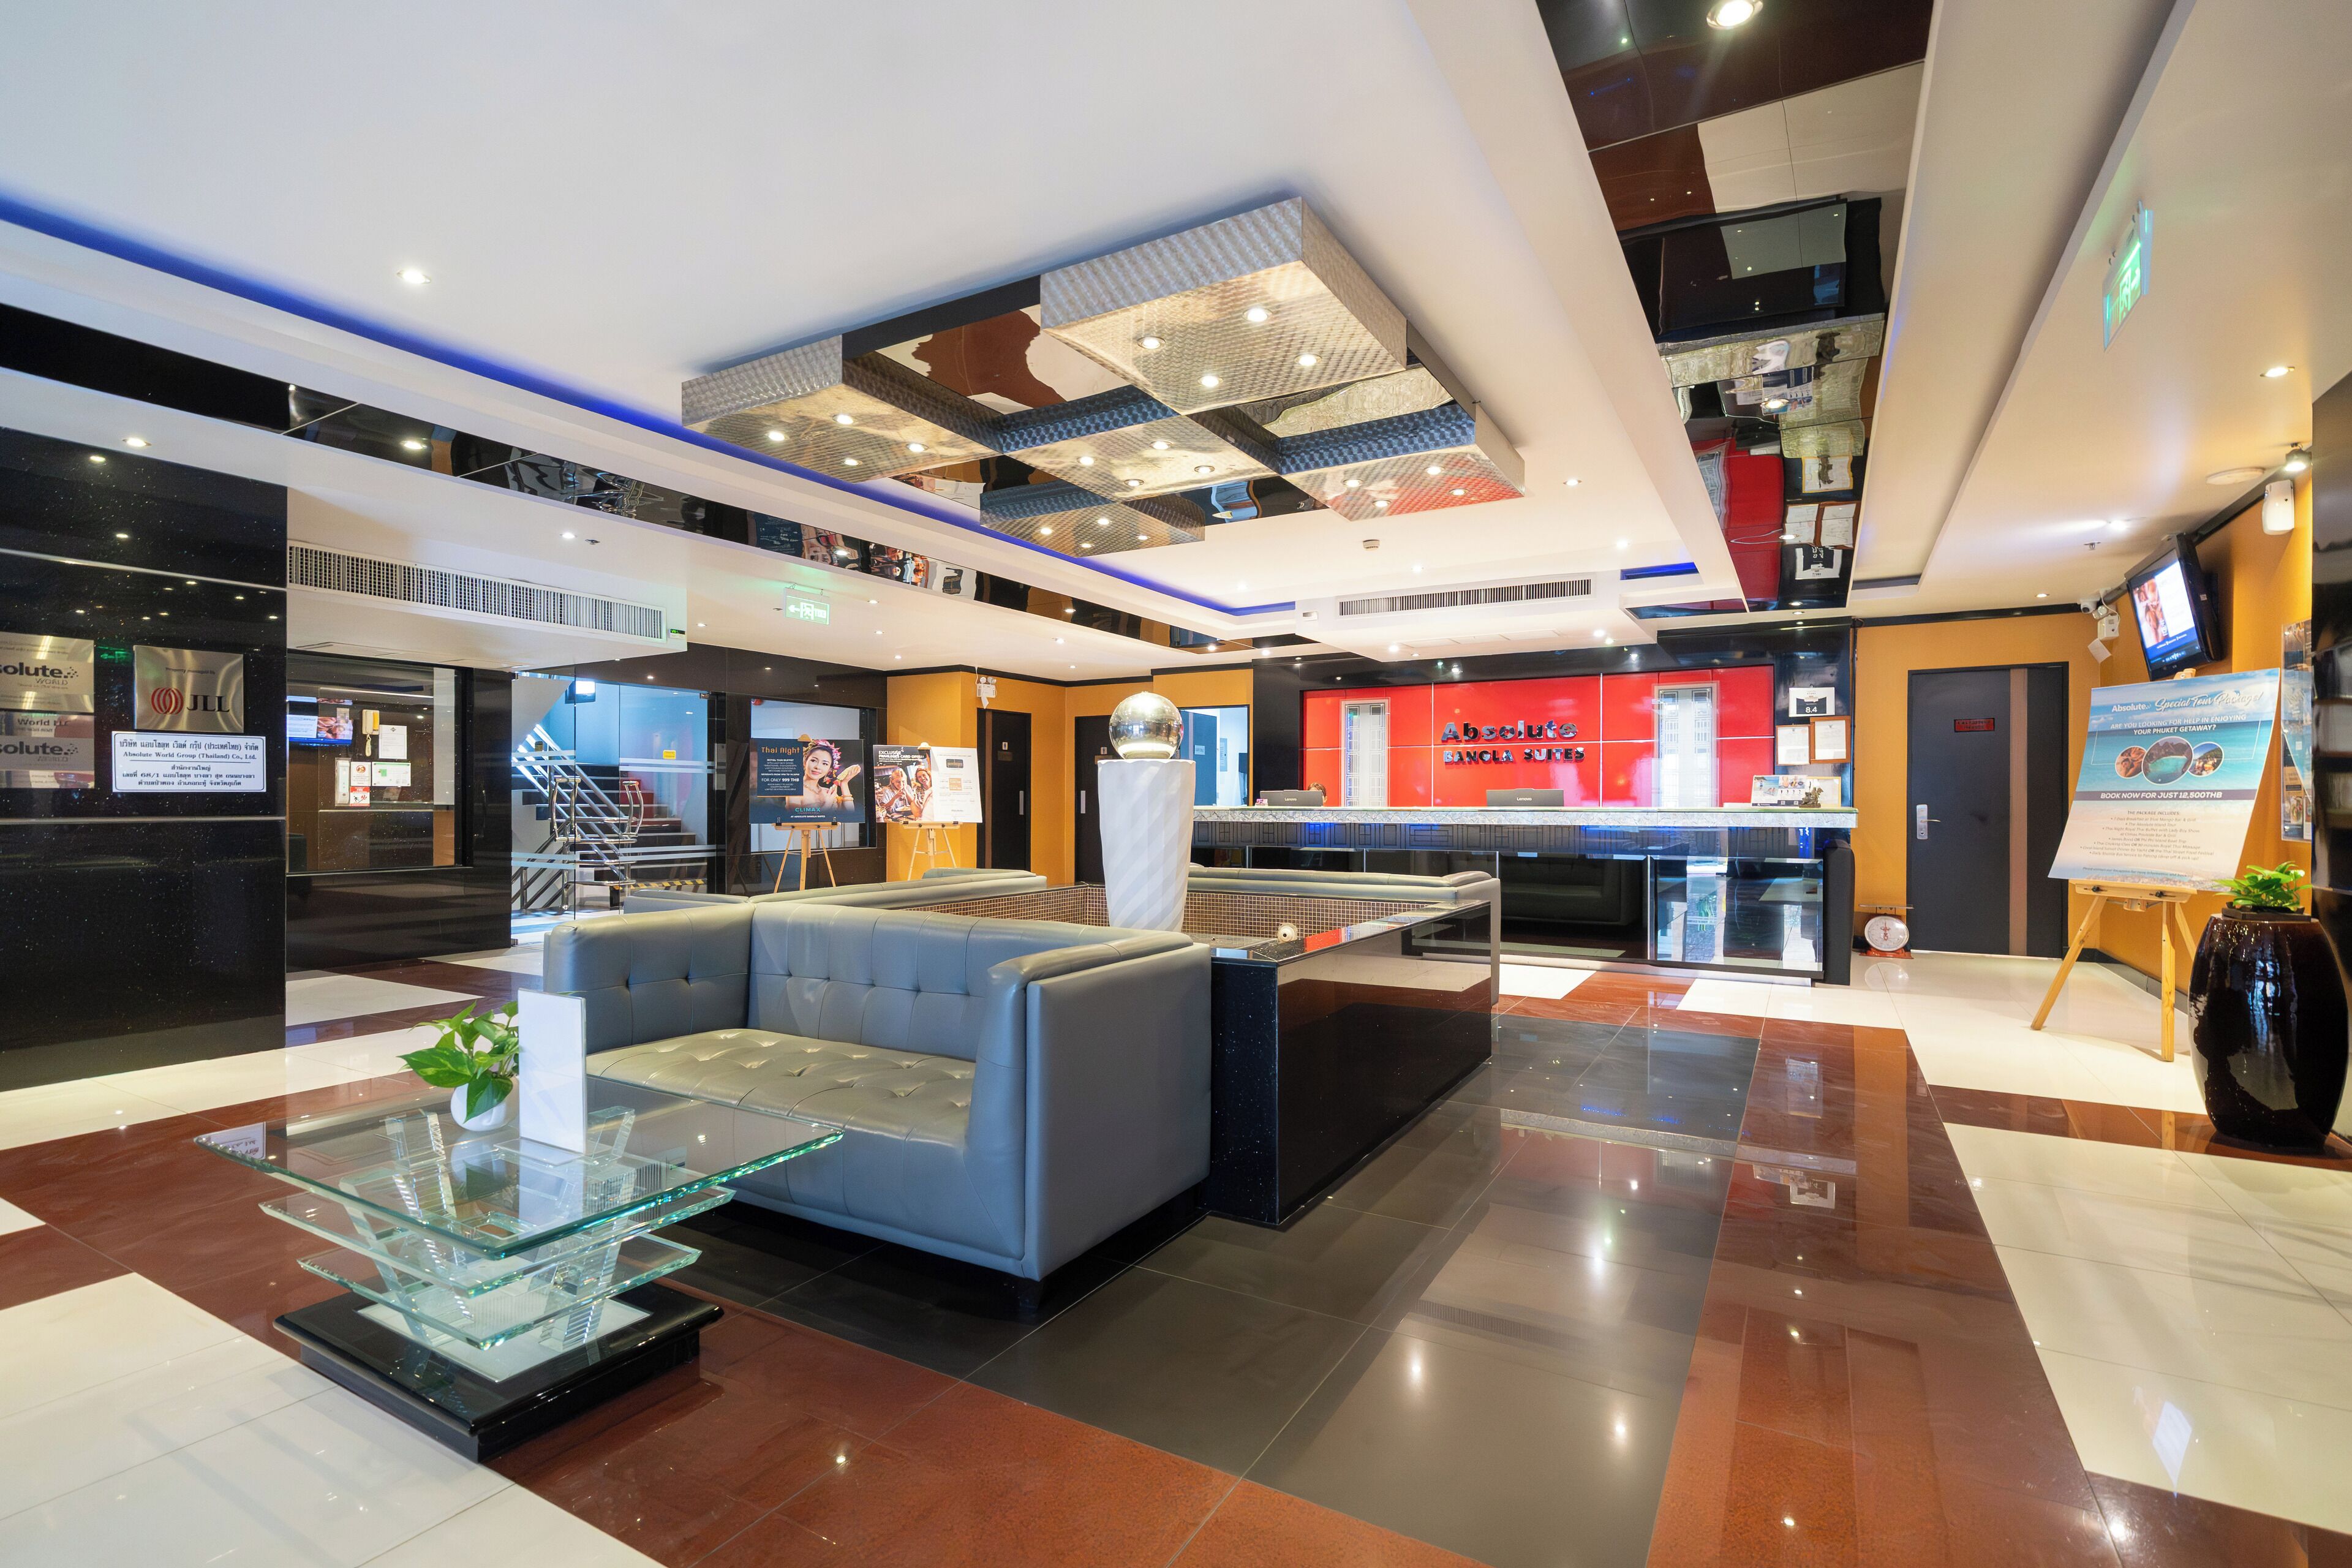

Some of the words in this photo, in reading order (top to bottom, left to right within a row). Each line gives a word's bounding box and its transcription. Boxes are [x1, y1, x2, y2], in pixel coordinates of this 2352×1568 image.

[187, 695, 230, 712] JLL
[2155, 697, 2190, 714] Special
[1441, 720, 1578, 742] Absolute
[2179, 724, 2216, 733] GETAWAY?
[1443, 750, 1514, 763] BANGLA
[1523, 747, 1586, 763] SUITES
